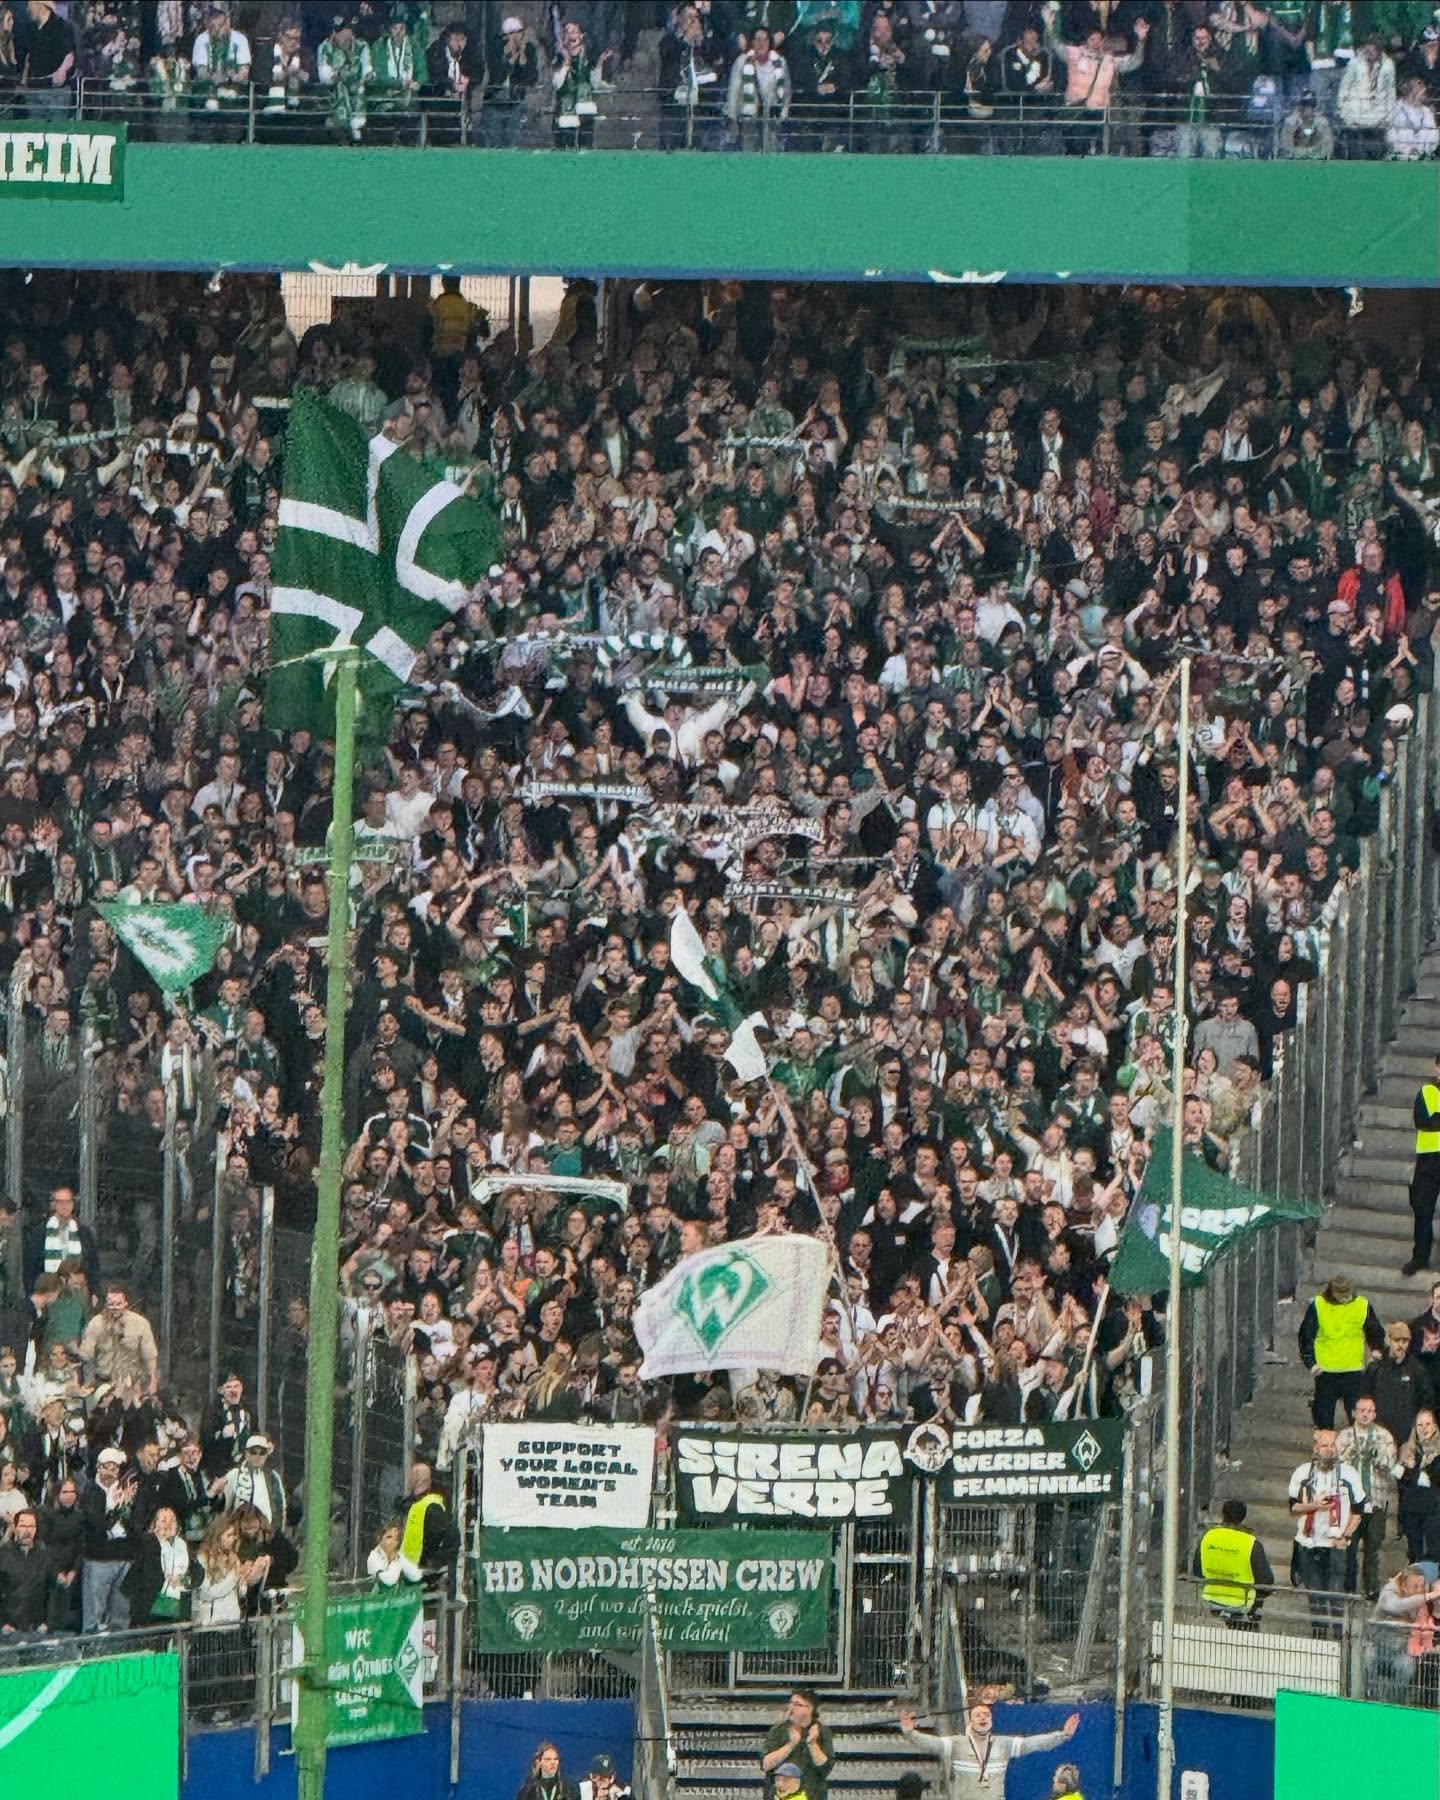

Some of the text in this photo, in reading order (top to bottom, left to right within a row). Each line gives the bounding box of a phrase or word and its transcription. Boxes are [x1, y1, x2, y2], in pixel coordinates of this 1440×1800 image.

[517, 1441, 622, 1457] SUPPORT
[953, 1428, 1045, 1450] FORZA
[500, 1458, 638, 1475] YOUR LOCAL
[953, 1452, 1066, 1473] WERDER
[536, 1493, 597, 1509] TEAM
[692, 1475, 893, 1518] VERDE
[482, 1556, 825, 1593] HB NORDHESSEN CREW
